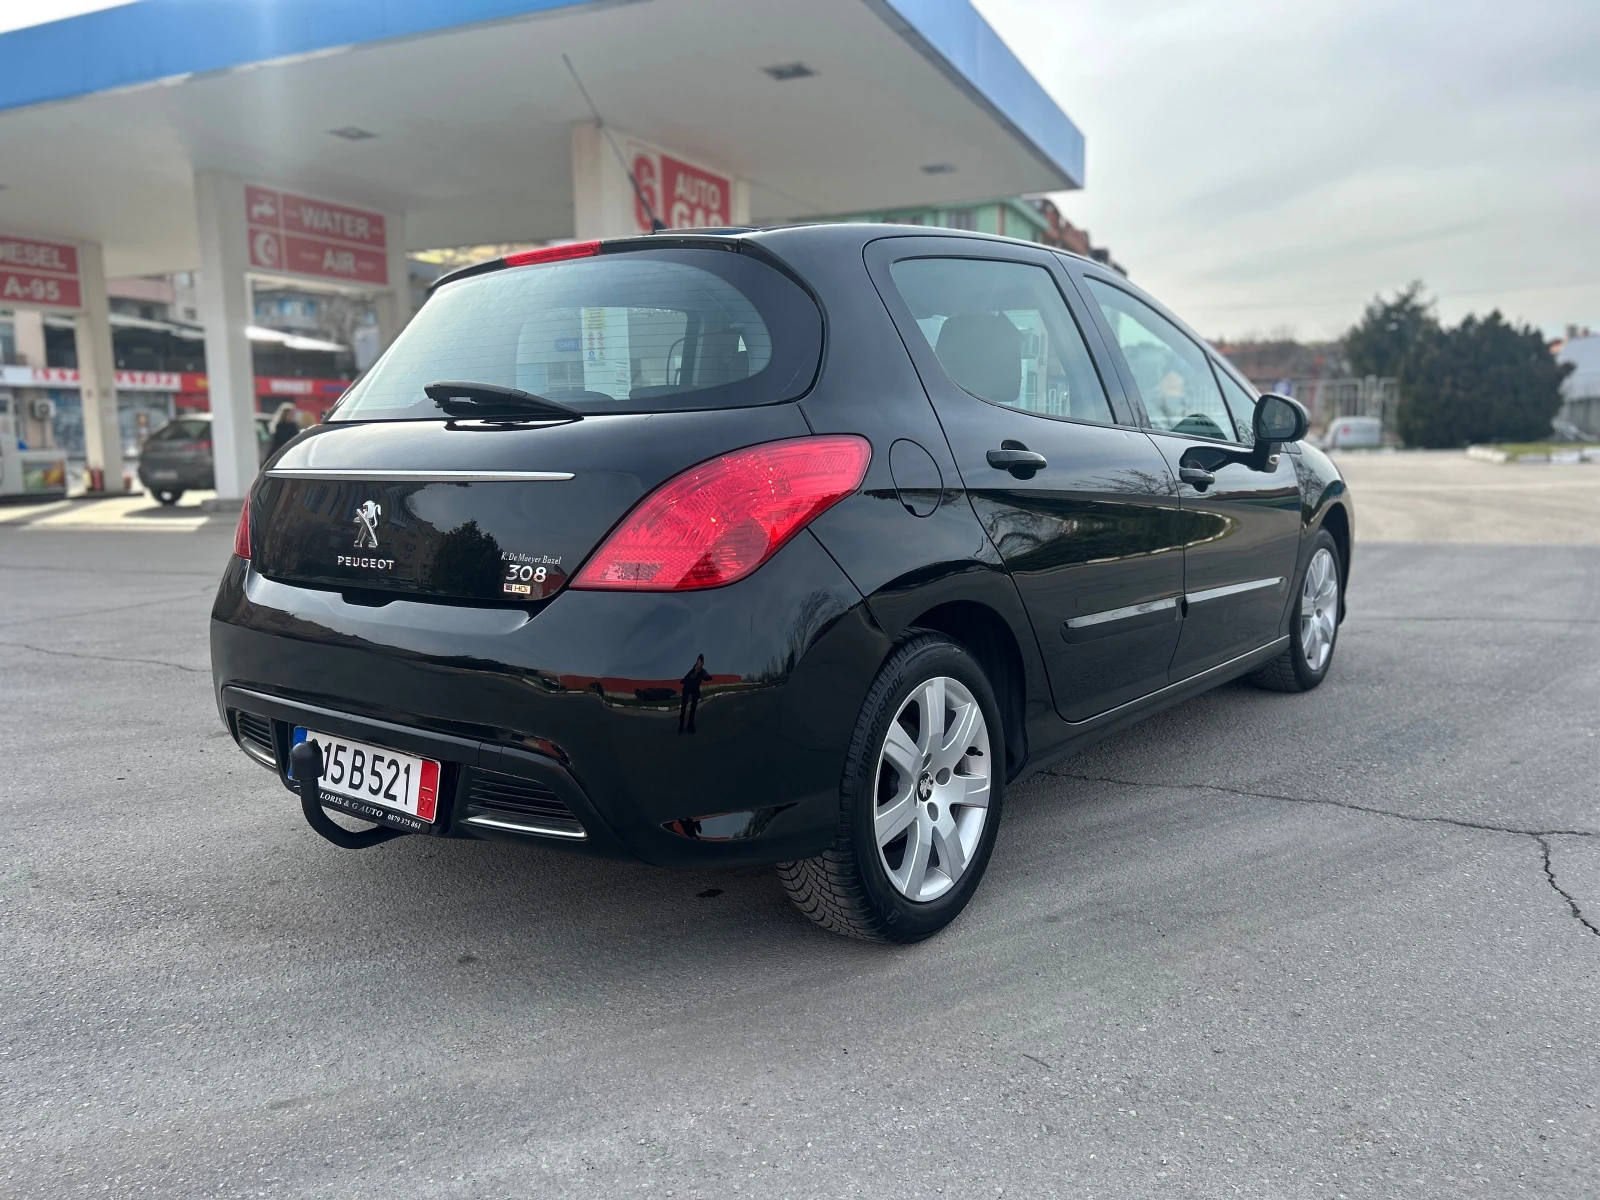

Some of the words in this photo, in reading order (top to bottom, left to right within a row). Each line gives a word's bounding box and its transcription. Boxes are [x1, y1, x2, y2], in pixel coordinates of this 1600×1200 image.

[673, 171, 722, 212] AUTO
[301, 204, 371, 240] WATER
[0, 243, 68, 270] IESEL
[323, 248, 357, 275] AIR
[4, 275, 61, 302] A-95
[337, 555, 395, 570] PEUGEOT
[505, 564, 547, 583] 308
[858, 671, 906, 782] BRIDGESTONE
[311, 739, 411, 806] 15B521
[319, 791, 343, 805] LORIS
[343, 799, 350, 808] &
[351, 802, 359, 810] G
[359, 804, 384, 818] AUTO
[418, 796, 432, 813] 27
